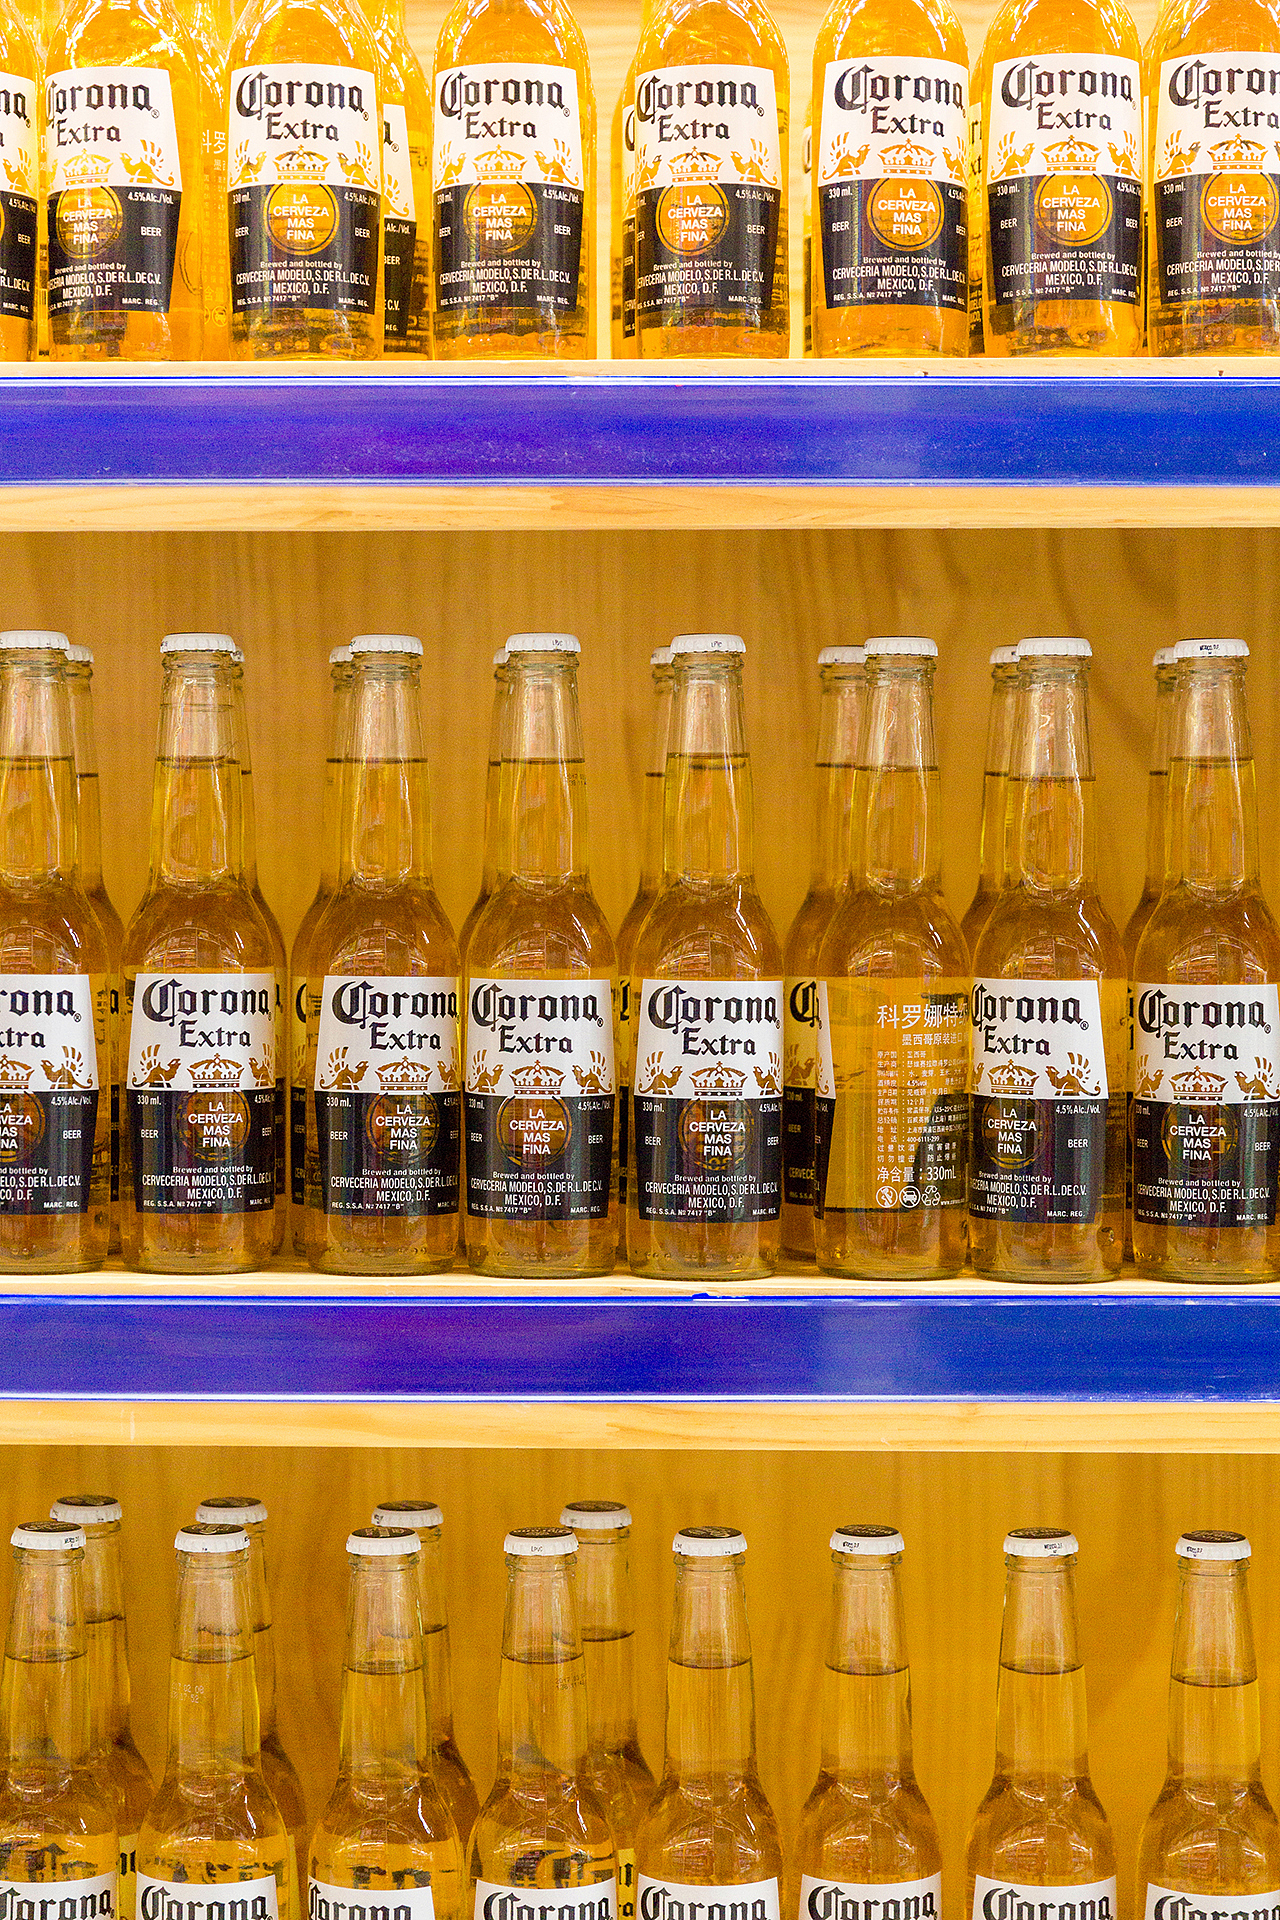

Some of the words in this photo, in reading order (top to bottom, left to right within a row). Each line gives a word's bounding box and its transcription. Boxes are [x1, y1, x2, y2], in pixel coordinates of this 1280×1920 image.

[834, 64, 964, 114] Corona
[1001, 61, 1133, 110] Corona
[1168, 59, 1280, 109] Coron
[236, 71, 364, 121] Corona
[440, 71, 565, 120] Corona
[636, 75, 759, 124] Corona
[1036, 101, 1112, 130] Extra
[1203, 99, 1280, 129] Extra
[265, 112, 339, 141] Extra
[465, 110, 537, 139] Extra
[870, 105, 944, 138] Extra
[57, 118, 121, 147] Extra
[658, 113, 730, 143] Extra
[900, 188, 916, 199] LA
[1063, 184, 1080, 195] LA
[1229, 183, 1246, 194] LA
[78, 199, 92, 208] LA
[293, 194, 308, 204] LA
[491, 194, 506, 204] LA
[687, 195, 702, 205] LA
[1042, 196, 1100, 208] CERVEZA
[1208, 195, 1267, 207] CERVEZA
[273, 206, 330, 217] CERVEZA
[473, 206, 527, 217] CERVEZA
[878, 199, 936, 212] CERVEZA
[63, 210, 113, 222] CERVEZA
[668, 207, 723, 219] CERVEZA
[893, 212, 922, 223] MAS
[1057, 208, 1086, 220] MAS
[1223, 207, 1252, 219] MAS
[74, 221, 98, 232] MAS
[287, 218, 314, 228] MAS
[485, 218, 513, 229] MAS
[681, 219, 708, 230] MAS
[831, 220, 850, 232] BEER
[1000, 218, 1017, 230] BEER
[1057, 220, 1086, 232] FINA
[1166, 216, 1183, 228] BEER
[1222, 219, 1252, 231] FINA
[141, 226, 162, 236] BEER
[286, 230, 315, 241] FINA
[354, 227, 371, 238] BEER
[485, 230, 513, 241] FINA
[554, 224, 571, 236] BEER
[747, 224, 765, 235] BEER
[892, 224, 922, 235] FINA
[73, 233, 99, 245] FINA
[680, 231, 708, 242] FINA
[1031, 251, 1060, 260] Brewed
[1062, 250, 1077, 259] and
[1078, 250, 1105, 260] bottled
[1107, 252, 1116, 262] by
[877, 278, 917, 291] MEXICO,
[919, 279, 935, 291] D.F.
[1045, 273, 1085, 286] MEXICO,
[1087, 274, 1103, 286] D.F.
[1211, 272, 1252, 285] MEXICO,
[1253, 273, 1270, 285] D.F.
[63, 287, 94, 300] MEXICO,
[95, 286, 112, 296] D.F.
[273, 283, 311, 295] MEXICO,
[313, 284, 330, 295] D.F.
[473, 282, 508, 294] MEXICO,
[510, 282, 527, 293] D.F.
[664, 283, 701, 296] MEXICO,
[703, 282, 719, 293] D.F.
[142, 978, 269, 1027] Corona
[332, 980, 458, 1029] Corona
[471, 982, 599, 1032] Corona
[971, 983, 1083, 1032] Corona
[648, 984, 777, 1034] Corona
[1138, 988, 1267, 1038] Corona
[178, 1019, 251, 1048] Extra
[369, 1021, 441, 1050] Extra
[498, 1024, 573, 1053] Extra
[681, 1027, 756, 1056] Extra
[983, 1024, 1051, 1056] Extra
[1163, 1031, 1239, 1060] Extra
[209, 1101, 225, 1112] LA
[397, 1104, 412, 1115] LA
[188, 1113, 243, 1124] CERVEZA
[529, 1108, 545, 1119] LA
[710, 1109, 726, 1120] LA
[1003, 1107, 1017, 1119] LA
[375, 1115, 431, 1126] CERVEZA
[509, 1119, 565, 1131] CERVEZA
[987, 1118, 1037, 1131] CERVEZA
[1189, 1114, 1205, 1125] LA
[203, 1125, 231, 1136] MAS
[689, 1121, 745, 1132] CERVEZA
[1170, 1125, 1227, 1137] CERVEZA
[63, 1129, 82, 1140] BEER
[140, 1128, 159, 1139] BEER
[330, 1130, 348, 1140] BEER
[390, 1127, 418, 1139] MAS
[523, 1132, 551, 1143] MAS
[704, 1133, 732, 1144] MAS
[998, 1131, 1022, 1143] MAS
[202, 1137, 231, 1148] FINA
[389, 1139, 418, 1150] FINA
[588, 1135, 603, 1145] BEER
[644, 1135, 661, 1146] BEER
[1067, 1138, 1089, 1149] BEER
[1183, 1138, 1211, 1149] MAS
[522, 1144, 551, 1155] FINA
[703, 1145, 732, 1156] FINA
[997, 1143, 1022, 1154] FINA
[1254, 1141, 1271, 1152] BEER
[1182, 1150, 1211, 1160] FINA
[173, 1165, 202, 1174] Brewed
[203, 1165, 218, 1173] and
[219, 1165, 244, 1173] bottled
[245, 1165, 253, 1174] by
[187, 1187, 226, 1201] MEXICO,
[227, 1187, 243, 1198] D.F.
[376, 1190, 415, 1203] MEXICO,
[416, 1190, 430, 1201] D.F.
[504, 1194, 543, 1207] MEXICO,
[545, 1195, 561, 1206] D.F.
[688, 1196, 727, 1210] MEXICO,
[729, 1197, 744, 1208] D.F.
[986, 1194, 1018, 1209] MEXICO,
[1021, 1198, 1037, 1209] D.F.
[1169, 1200, 1207, 1214] MEXICO,
[1209, 1201, 1227, 1213] D.F.
